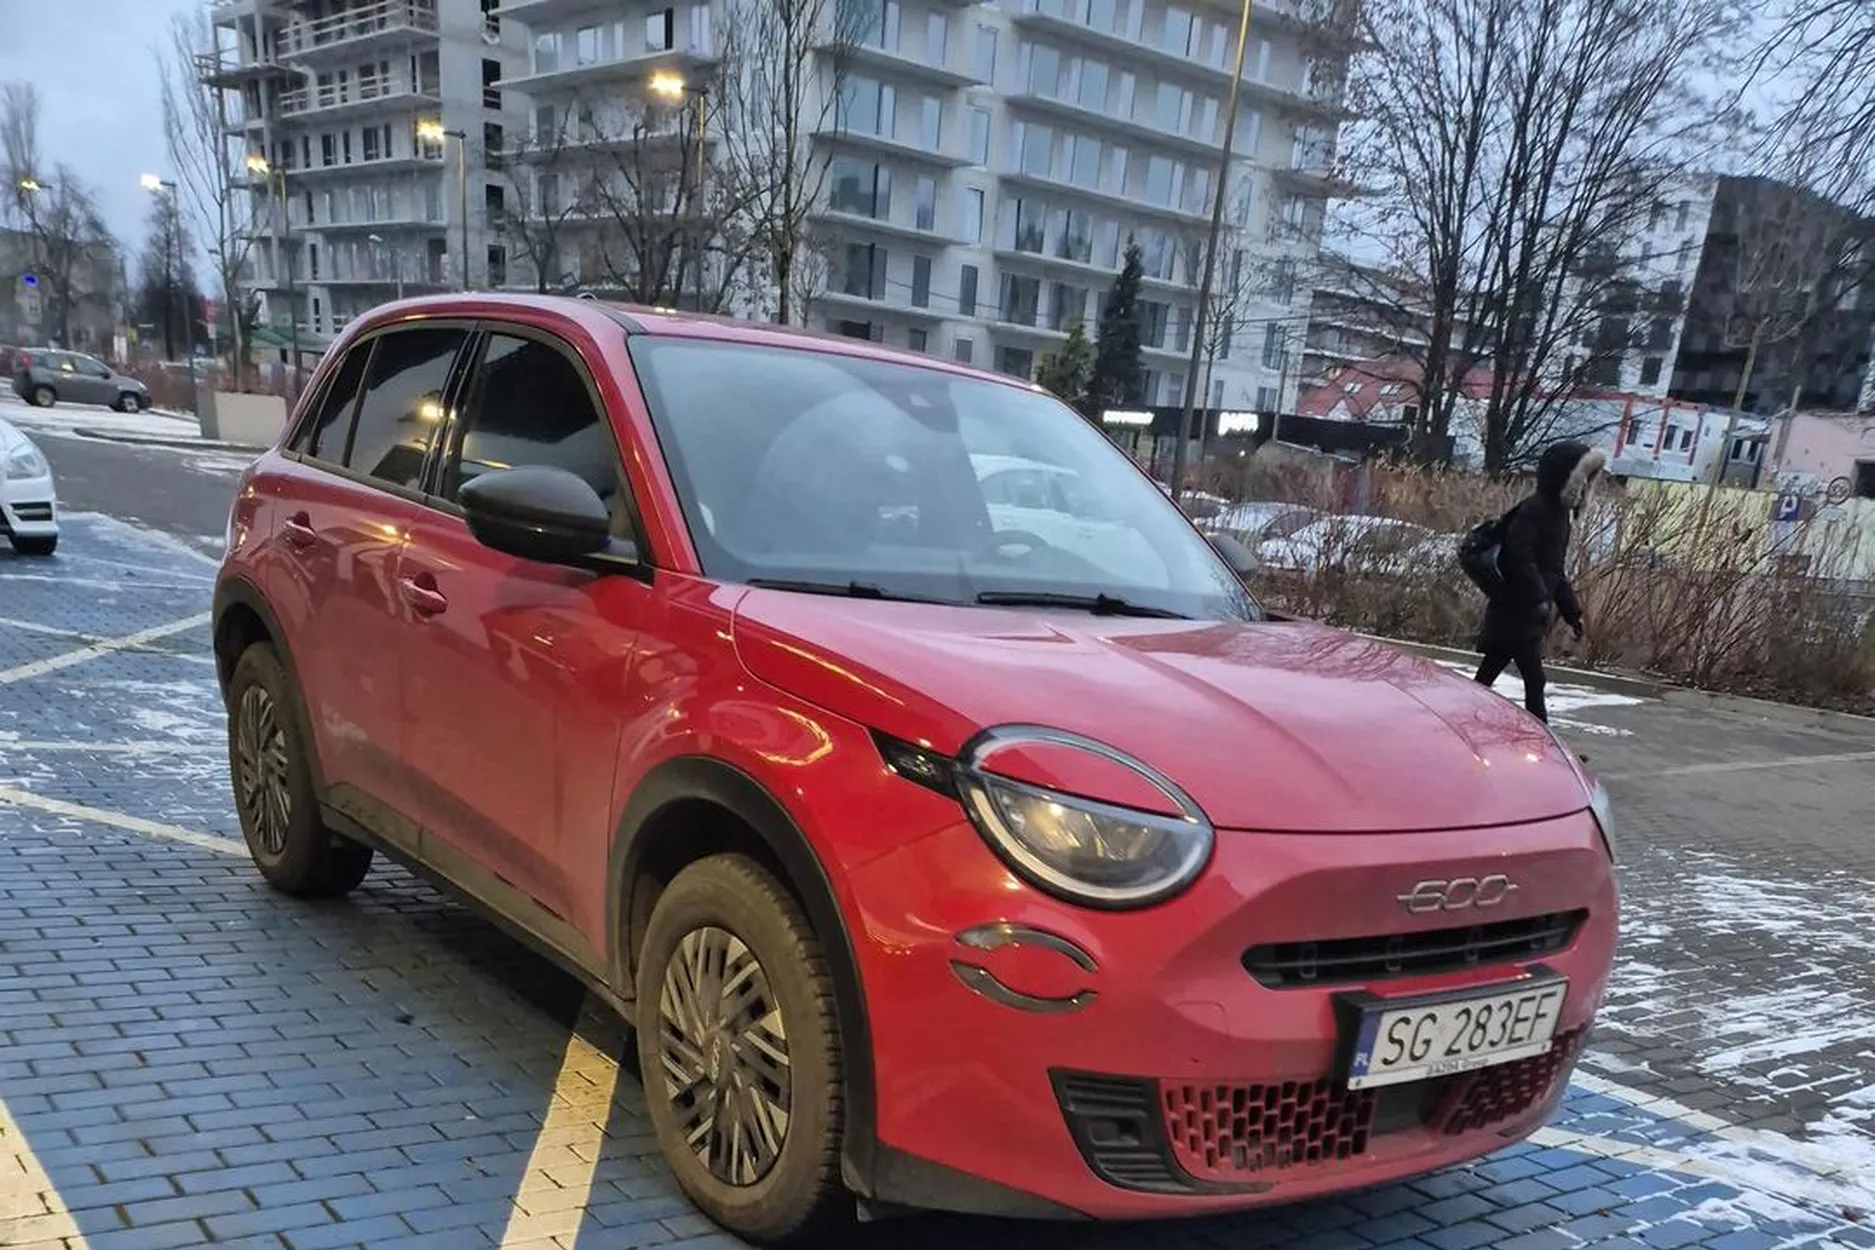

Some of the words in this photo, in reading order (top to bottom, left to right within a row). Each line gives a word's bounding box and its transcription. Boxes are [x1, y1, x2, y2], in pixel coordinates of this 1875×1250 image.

[1779, 495, 1798, 519] P
[1398, 874, 1519, 912] 600
[1382, 1012, 1438, 1066] SG
[1444, 991, 1557, 1056] 283EF
[1353, 1052, 1371, 1067] PL
